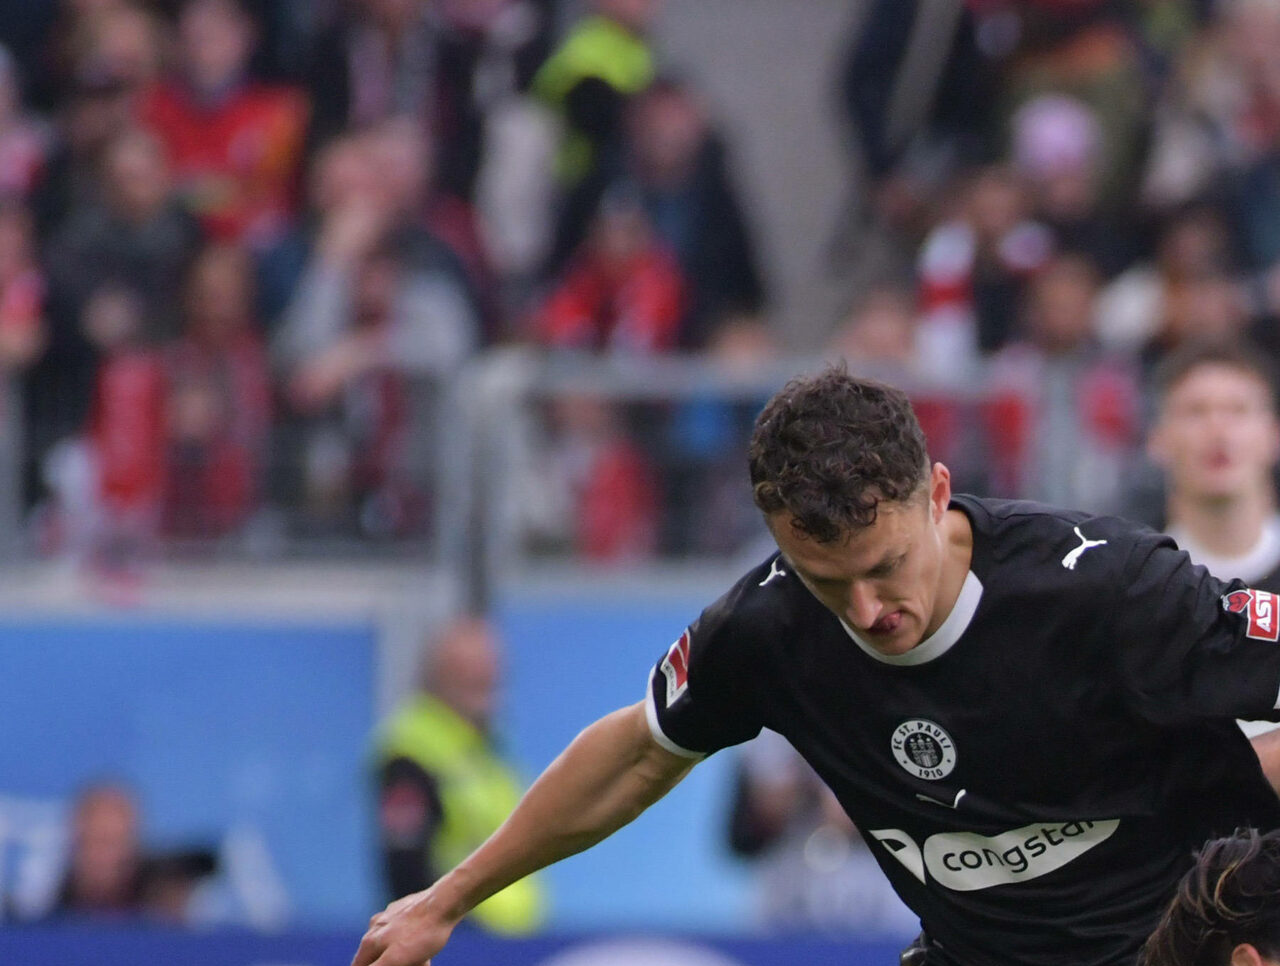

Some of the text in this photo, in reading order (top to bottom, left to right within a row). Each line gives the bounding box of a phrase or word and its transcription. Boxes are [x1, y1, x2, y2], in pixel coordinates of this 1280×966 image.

[893, 738, 903, 750] FC
[917, 722, 951, 749] PAULI
[919, 768, 943, 778] 1910
